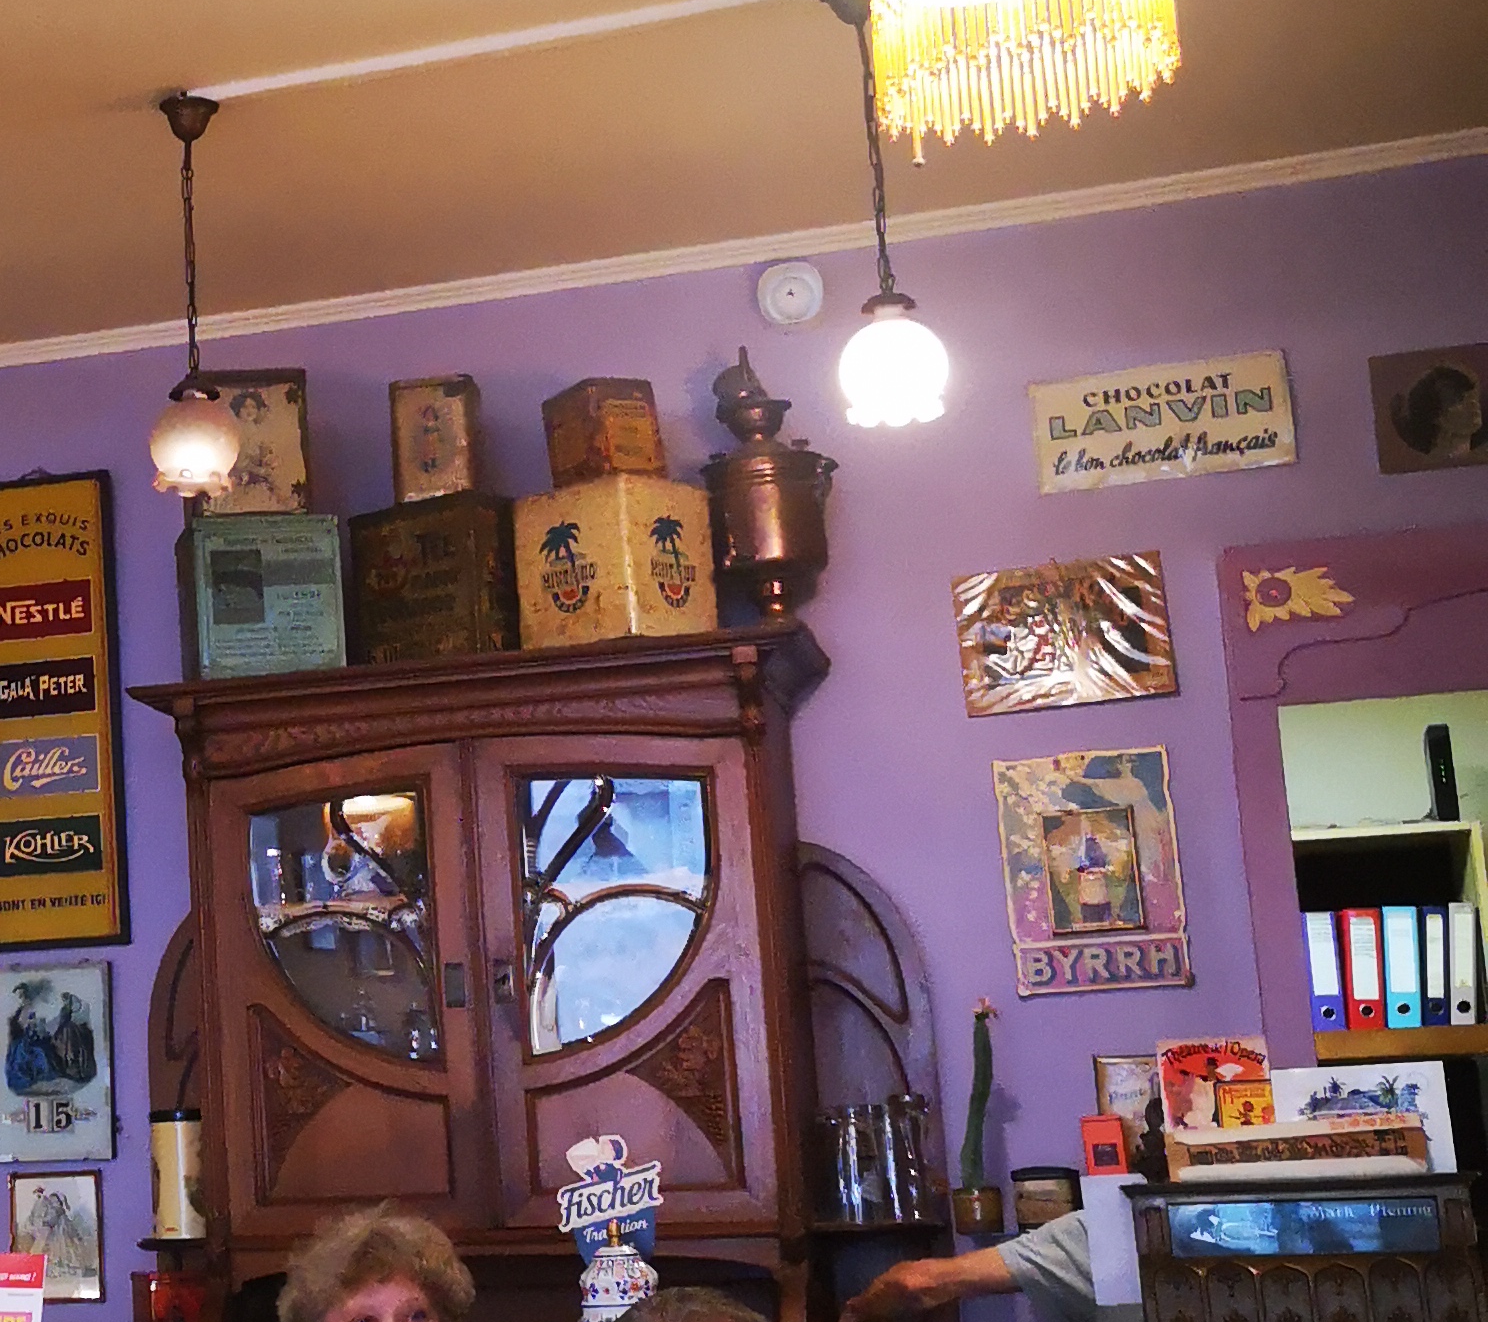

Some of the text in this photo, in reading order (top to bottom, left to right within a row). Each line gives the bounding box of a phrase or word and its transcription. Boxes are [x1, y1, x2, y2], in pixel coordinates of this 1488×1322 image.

[1083, 372, 1232, 407] CHOCOLAT
[1049, 386, 1273, 441] LANVIN
[21, 511, 90, 531] EXQUIS
[39, 673, 87, 701] PETER
[3, 746, 87, 790] Cailler
[4, 829, 94, 864] KOHLER
[30, 897, 46, 910] EN
[1026, 943, 1181, 986] BYRRH
[31, 1102, 73, 1130] 15
[560, 1165, 658, 1228] Fischer
[583, 1218, 648, 1243] Tration
